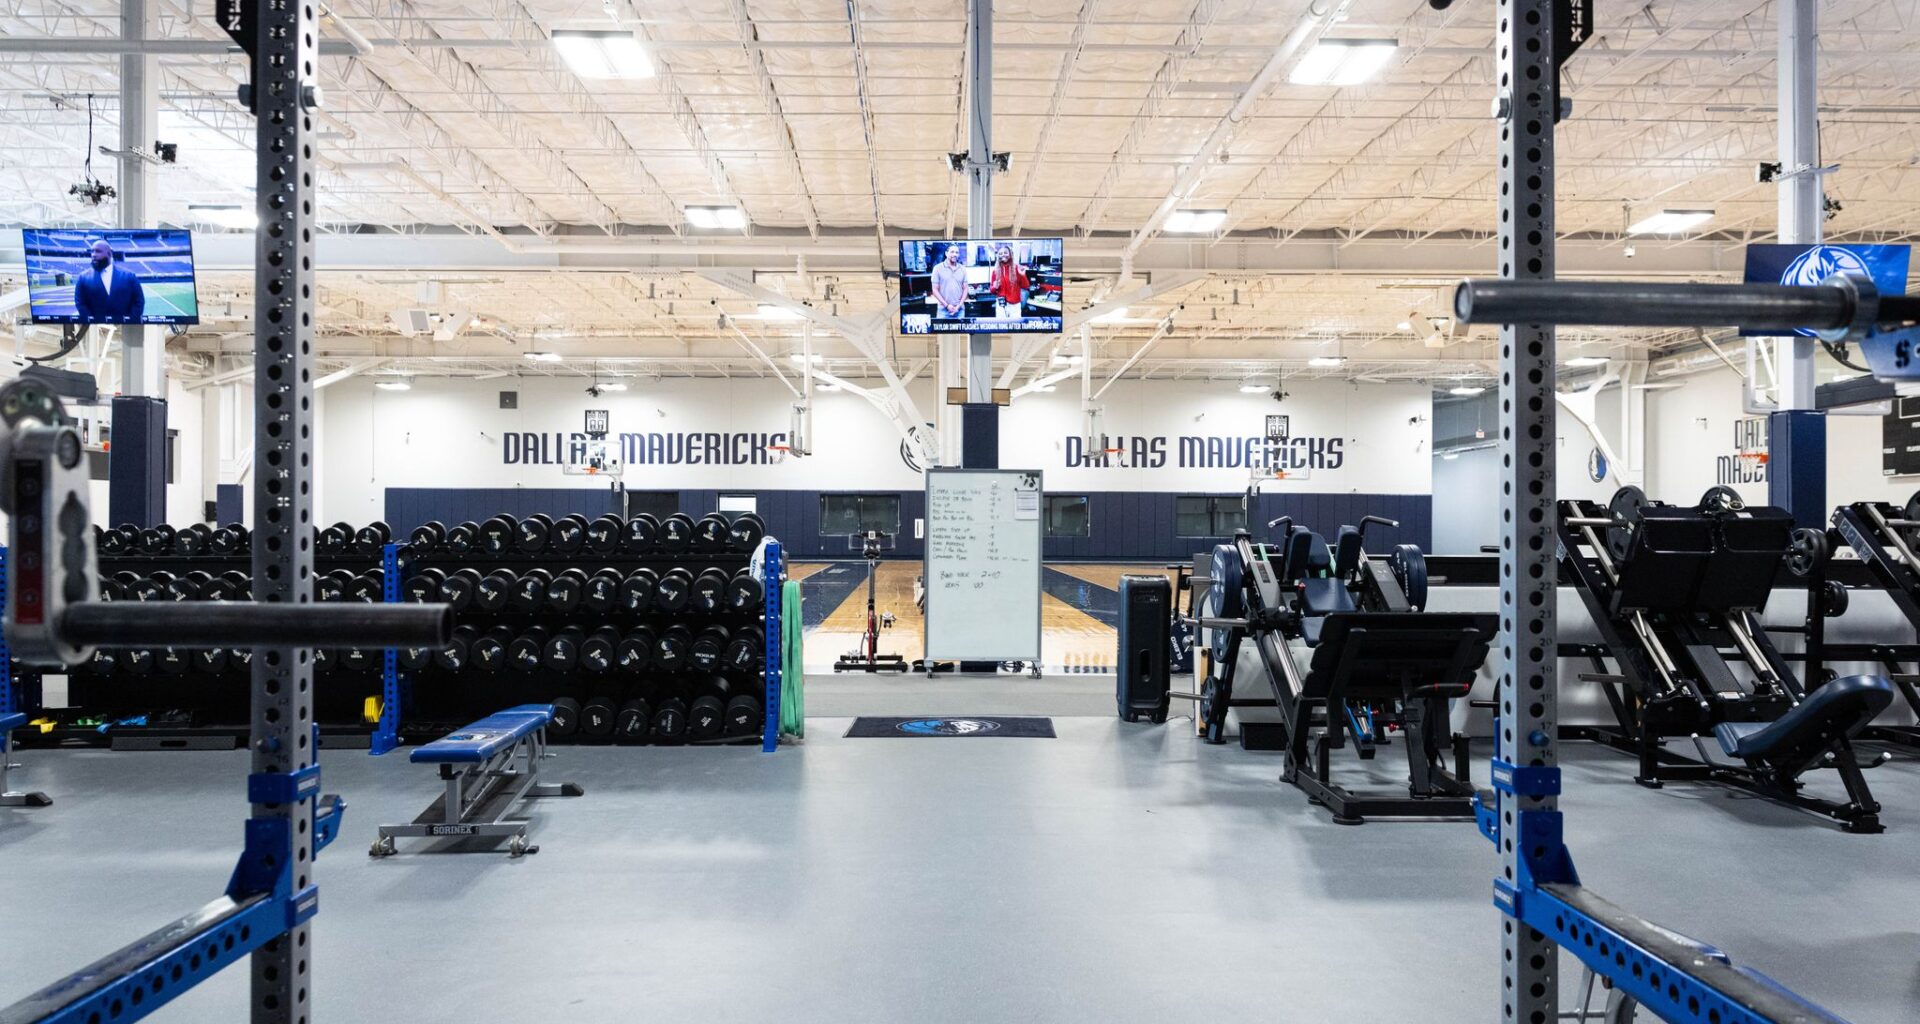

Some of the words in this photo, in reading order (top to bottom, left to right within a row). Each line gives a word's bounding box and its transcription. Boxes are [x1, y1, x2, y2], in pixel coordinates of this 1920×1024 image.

[907, 324, 928, 334] LIVE
[1538, 331, 1550, 341] 31
[1895, 338, 1910, 369] S
[503, 432, 606, 465] DALLA
[619, 432, 787, 465] MAVERICKS
[1178, 436, 1344, 470] MAVERICKS
[1538, 498, 1552, 507] 25
[1539, 581, 1552, 591] 22
[1539, 637, 1552, 647] 20
[1170, 636, 1183, 660] ELEIKO
[1541, 720, 1552, 730] 17
[433, 825, 473, 835] SORINEX
